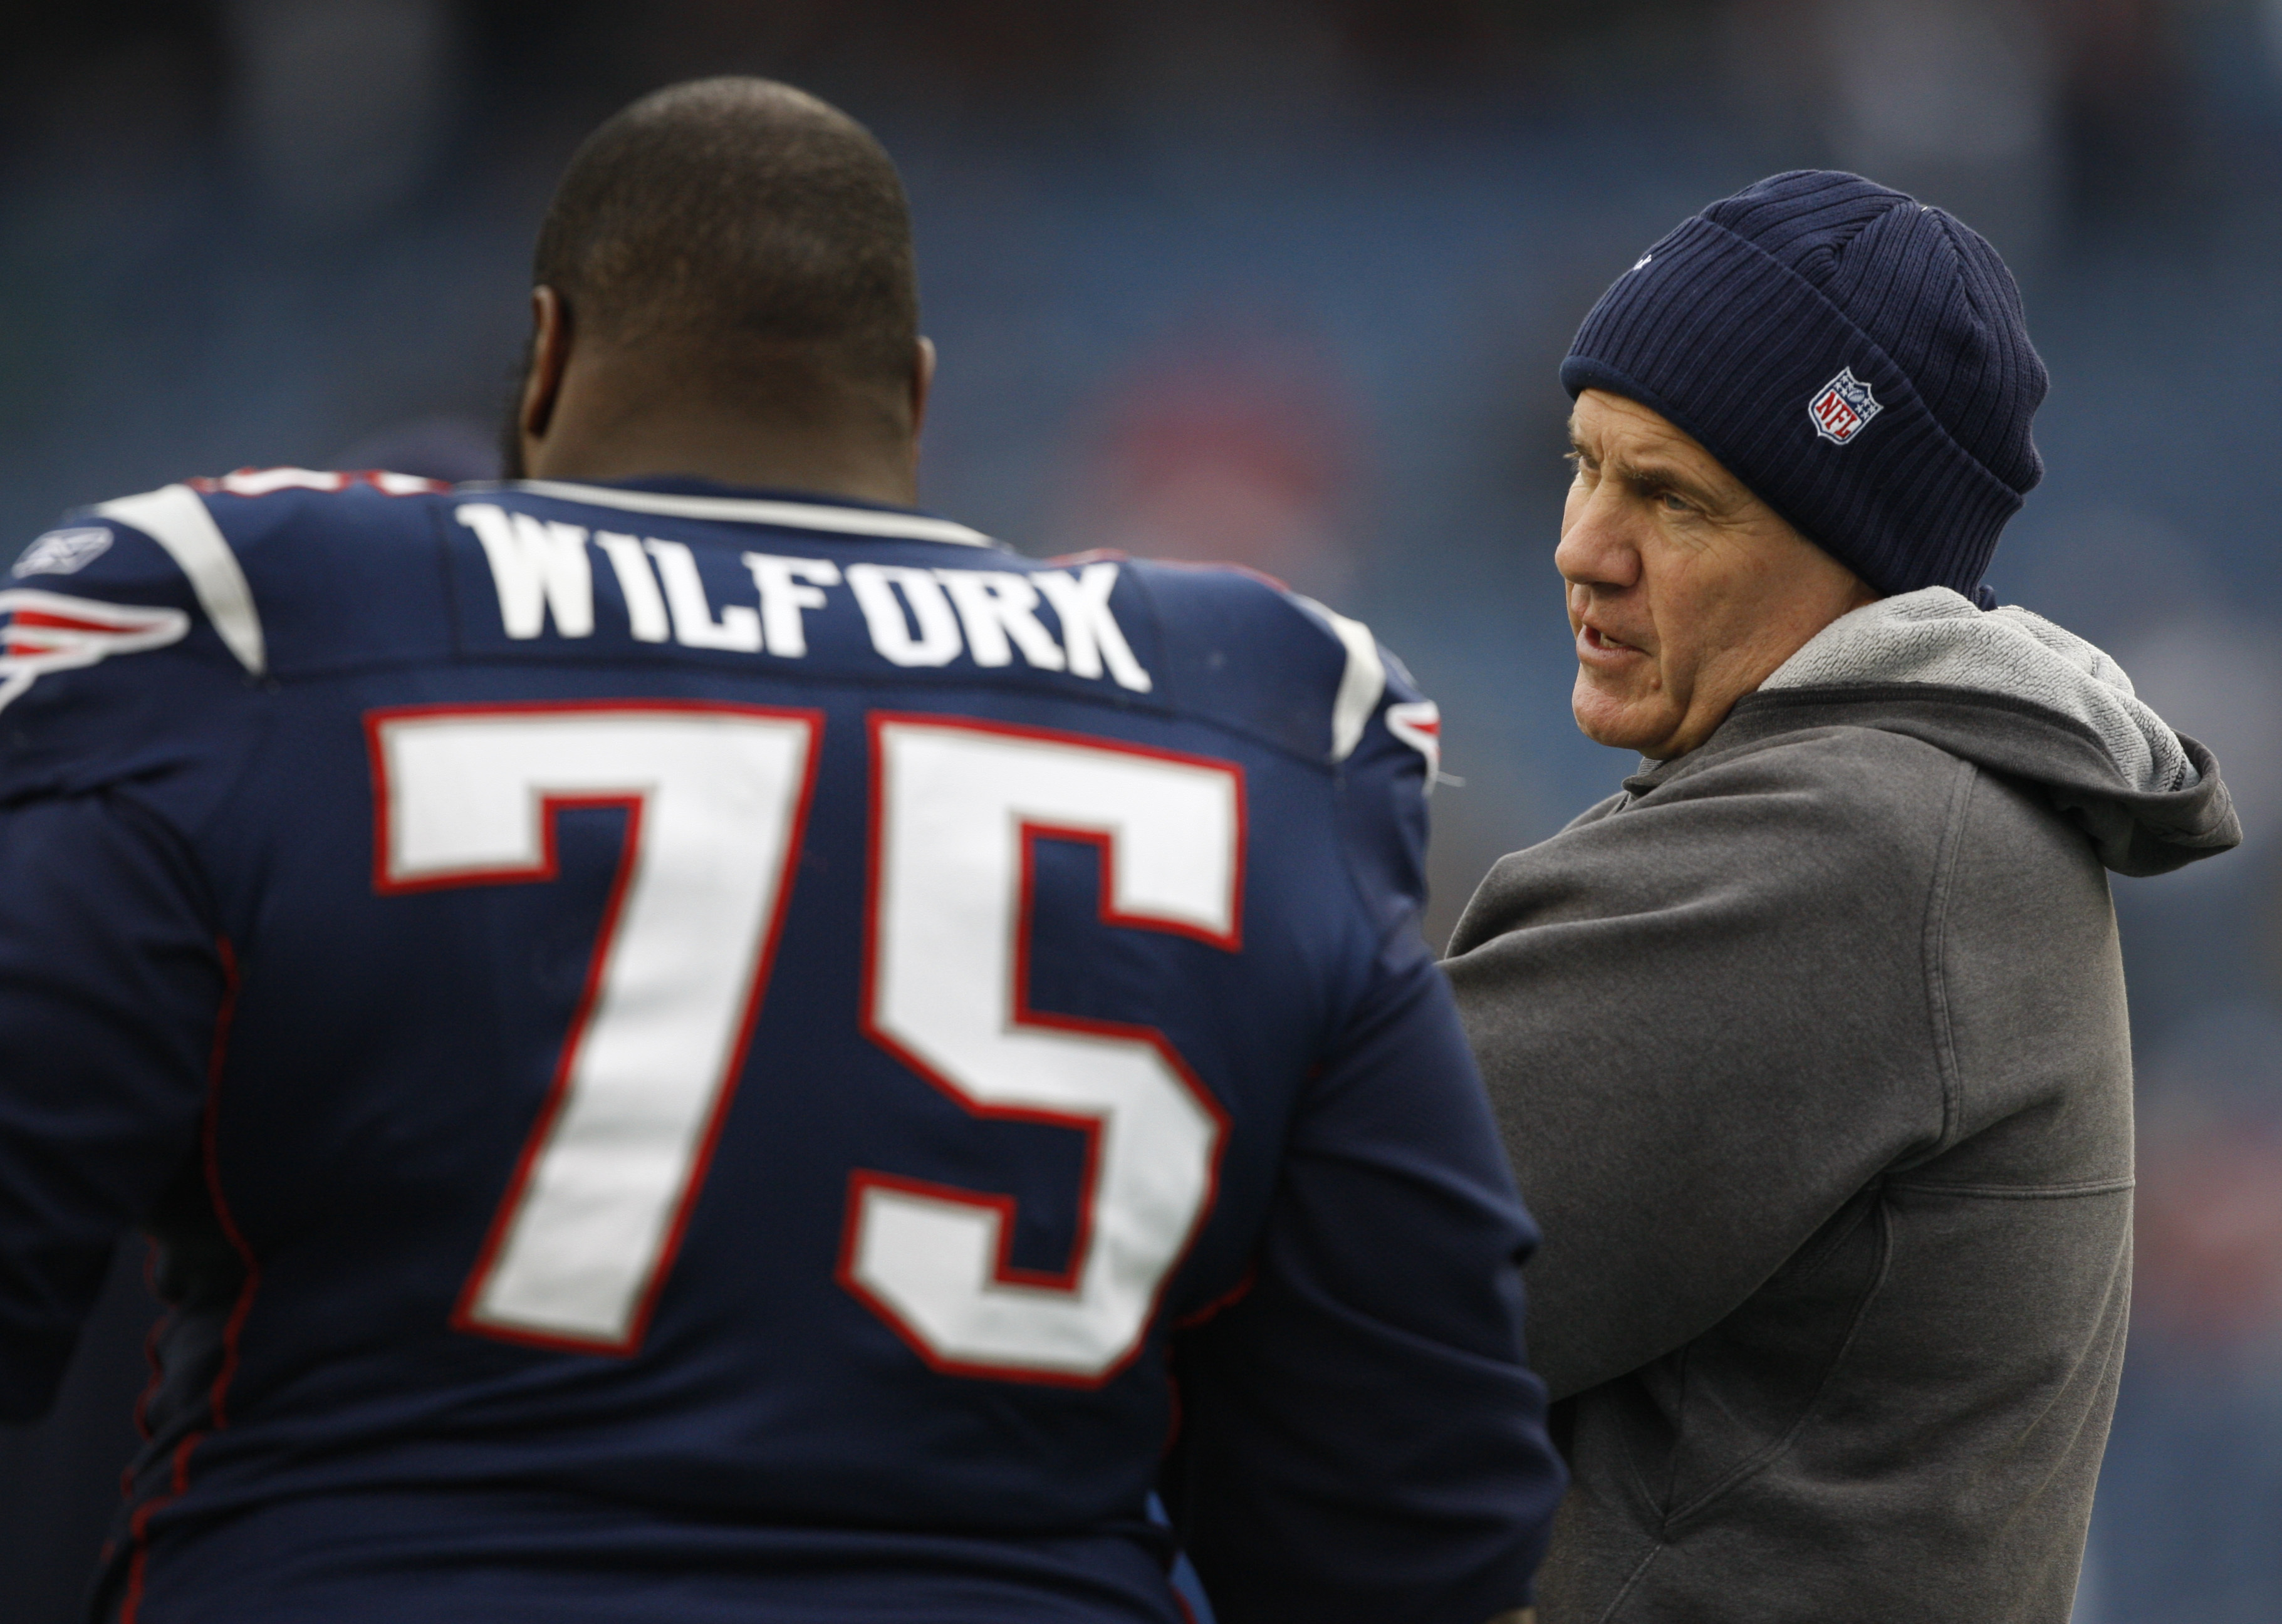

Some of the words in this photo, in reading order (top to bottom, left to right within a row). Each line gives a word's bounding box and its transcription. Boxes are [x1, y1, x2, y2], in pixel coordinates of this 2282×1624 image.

[1815, 391, 1858, 439] NFL
[456, 503, 1152, 692] WILFORK
[365, 700, 1245, 1386] 75
